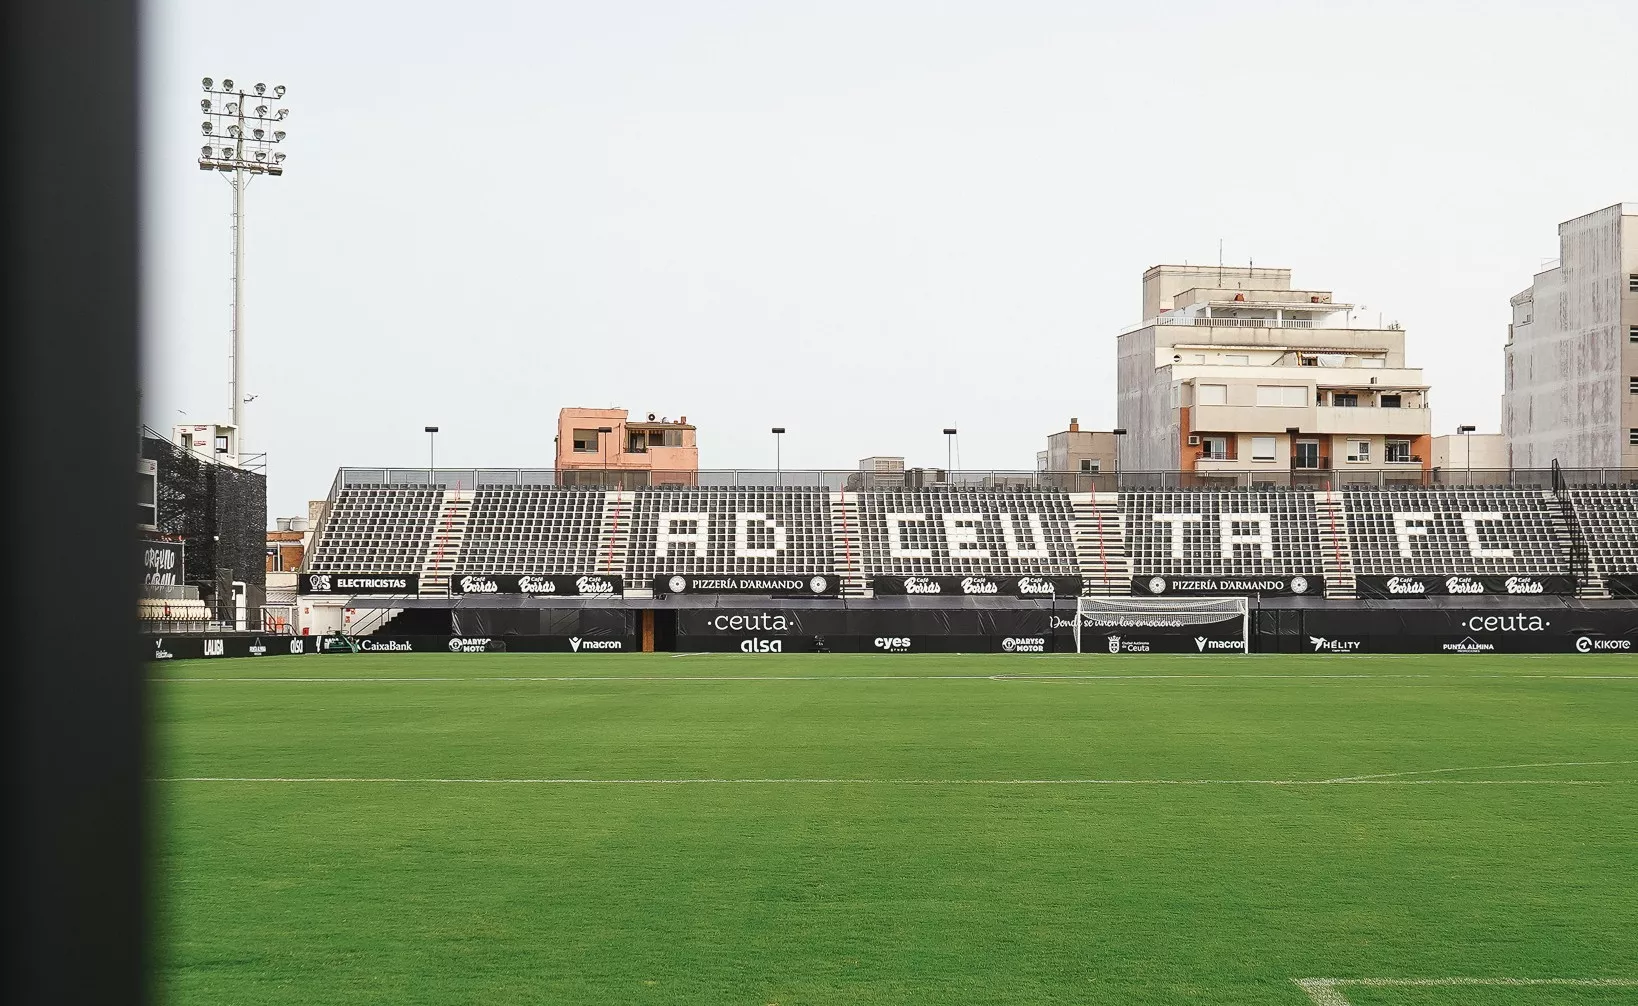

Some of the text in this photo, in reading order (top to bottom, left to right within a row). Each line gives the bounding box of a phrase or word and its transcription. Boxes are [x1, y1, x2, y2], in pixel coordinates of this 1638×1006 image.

[657, 512, 785, 558] AD
[1393, 512, 1513, 558] FC
[337, 579, 406, 588] ELECTRICISTAS
[692, 578, 803, 589] PIZZERÍA D'ARMANDO
[1172, 579, 1284, 590] PIZZERÍA D'ARMANDO
[714, 613, 788, 631] ceuta
[1469, 613, 1544, 631] ceuta
[204, 639, 225, 656] LALIGA
[361, 640, 413, 651] CaixaBank
[583, 640, 622, 649] macron
[741, 638, 782, 653] alsa
[874, 637, 911, 649] cyes
[1127, 644, 1150, 652] Ceuta
